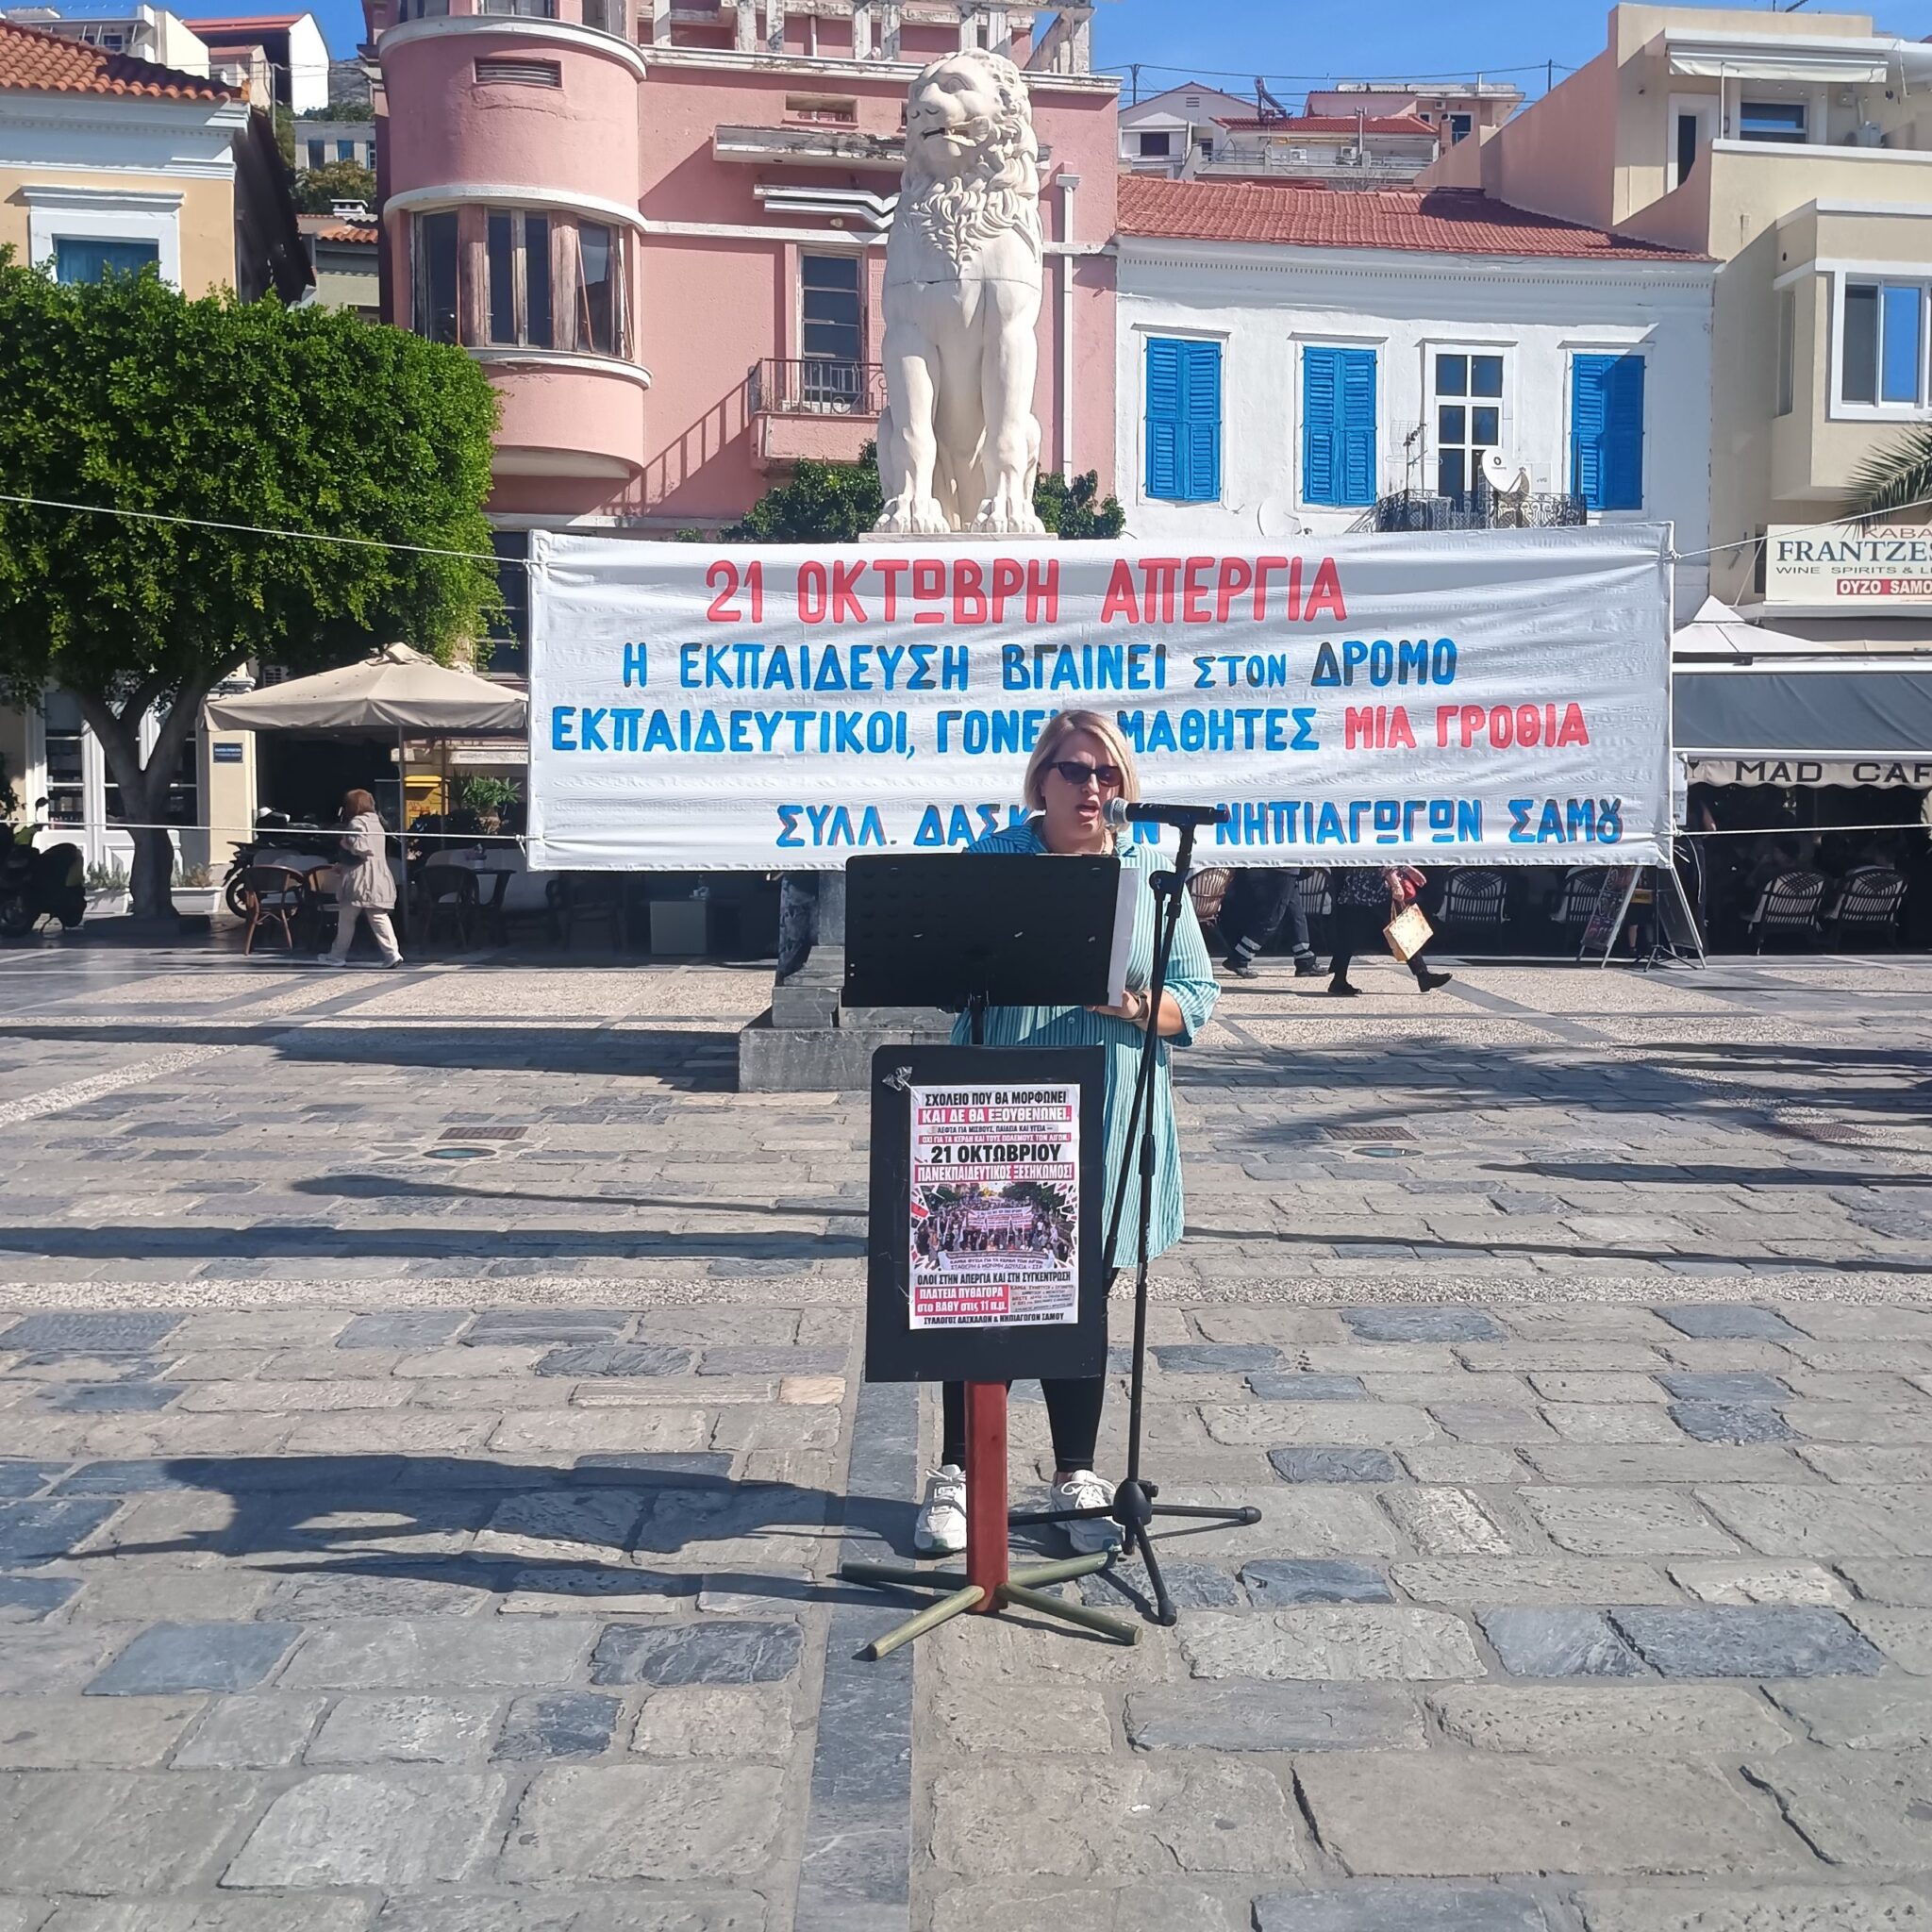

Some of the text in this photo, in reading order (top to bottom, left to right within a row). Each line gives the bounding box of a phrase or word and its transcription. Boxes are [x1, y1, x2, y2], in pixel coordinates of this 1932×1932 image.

[707, 557, 1347, 625] 21 ΟΚΤΩΒΡΗ ΑΠΕΡΓΙΑ
[623, 637, 1458, 691] Η ΕΚΠΑΙΔΕΥΣΗ ΒΓΑΙΝΕΙ ΣΤΟΝ ΔΡΟΜΟ
[551, 706, 916, 761] ΕΚΠΑΙΔΕΥΤΙΚΟΙ,
[1117, 706, 1320, 755] ΜΑΘΗΤΕΣ
[1344, 706, 1417, 751] ΜΙΑ
[1436, 702, 1590, 750] ΓΡΟΘΙΑ
[1735, 760, 1823, 783] MAD
[775, 804, 898, 847] ΣΥΛΛ.
[1214, 801, 1483, 846] ΝΗΠΙΑΓΩΓΩΝ
[925, 1091, 1066, 1106] ΣΧΟΛΕΙΟ ΠΟΥ ΘΑ ΜΟΡΦΩΝΕΙ
[923, 1109, 945, 1124] ΚΑΙ
[949, 1108, 964, 1123] ΔΕ
[969, 1108, 985, 1123] ΘΑ
[931, 1144, 1061, 1163] 21 ΟΚΤΩΒΡΙΟΥ
[918, 1163, 1073, 1181] ΠΑΝΕΚΠΑΙΔΕΥΤΙΚΟΣ ΞΕΣΗΚΩΜΟΣ!
[918, 1272, 1072, 1285] ΟΛΟΙ ΣΤΗΝ ΑΠΕΡΓΙΑ ΚΑΙ ΣΤΗ ΣΥΓΚΕΝΤΡΩΣΗ
[920, 1286, 1004, 1300] ΠΛΑΤΕΙΑ ΠΥΘΑΓΟΡΑ
[917, 1303, 934, 1313] στο
[935, 1301, 959, 1312] ΒΑΘΥ
[960, 1302, 979, 1312] στις
[980, 1300, 990, 1311] 11
[1041, 1312, 1064, 1322] ΣΑΜΟΥ
